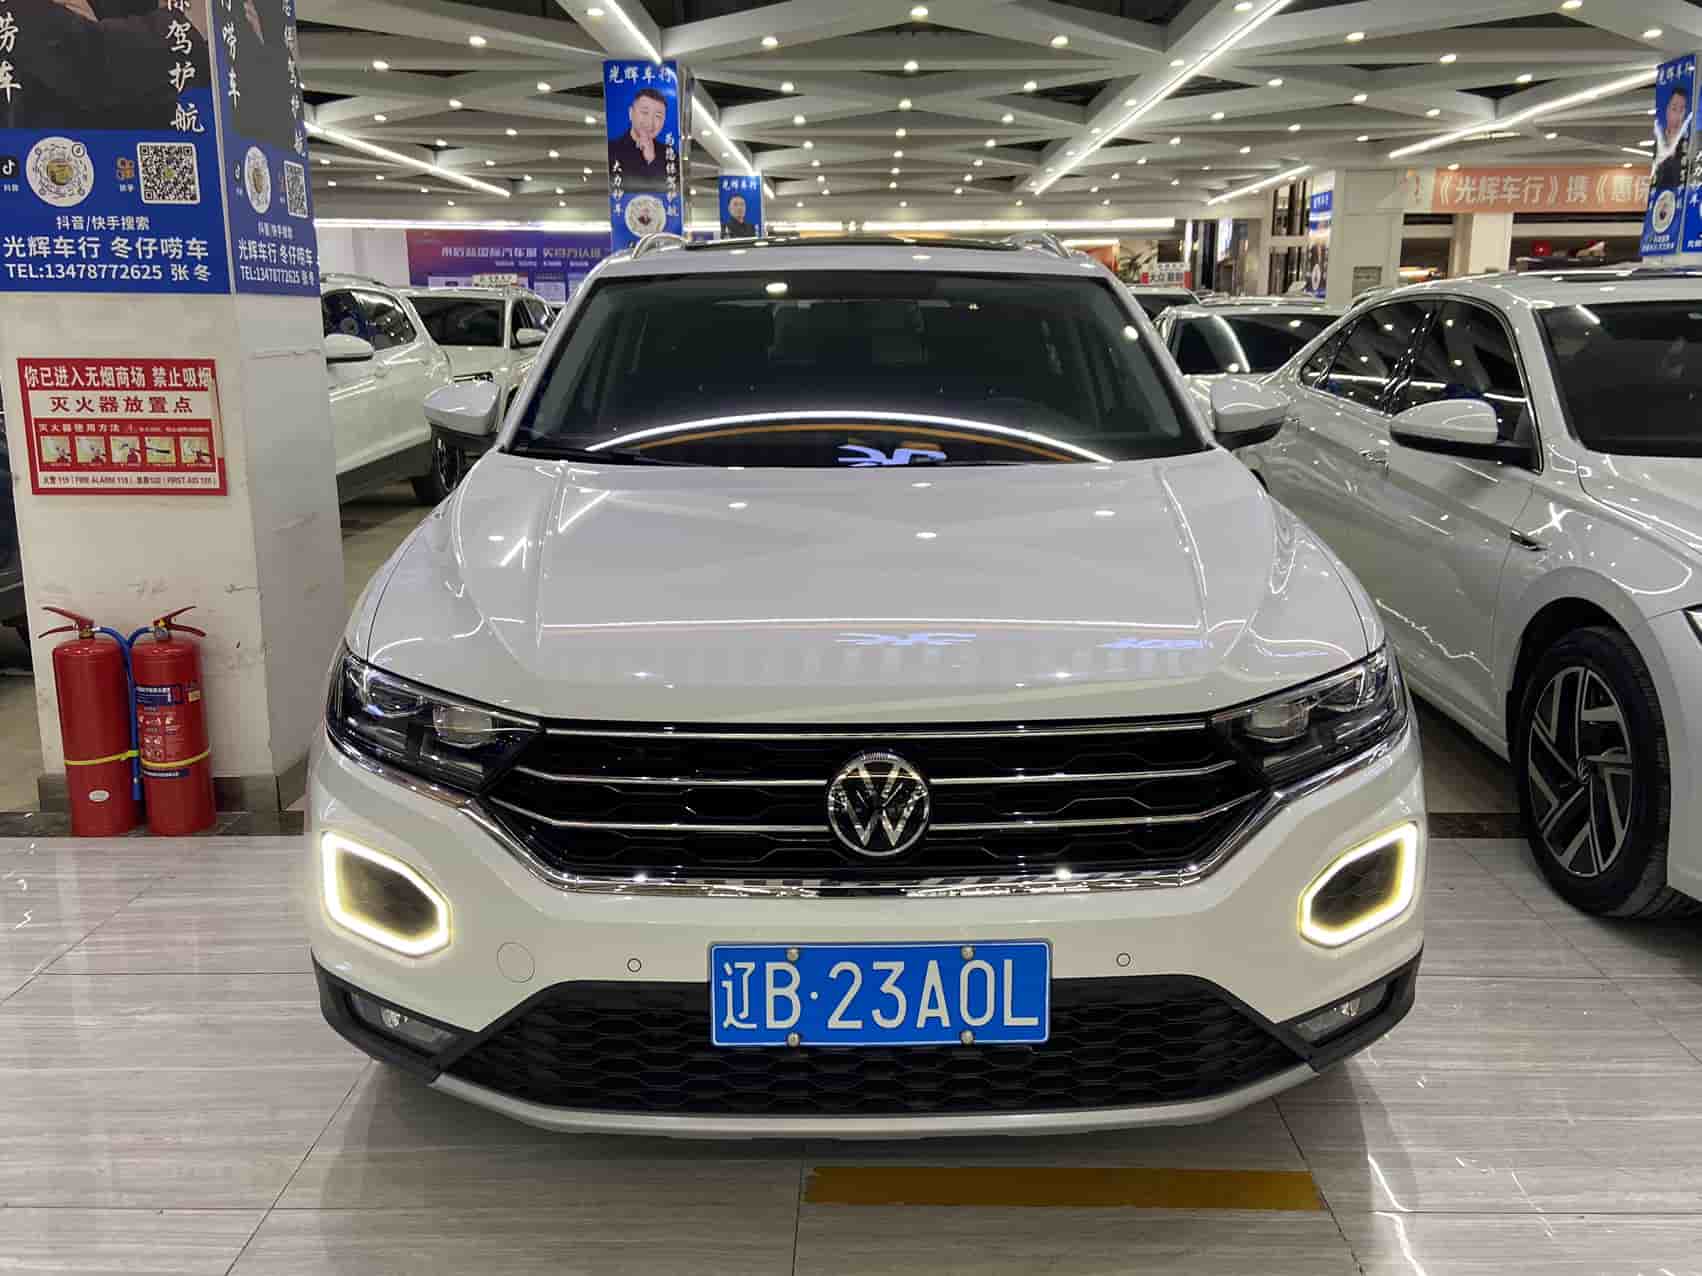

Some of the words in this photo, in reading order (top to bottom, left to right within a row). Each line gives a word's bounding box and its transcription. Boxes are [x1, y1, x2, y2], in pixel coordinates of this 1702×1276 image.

[56, 215, 150, 231] 抖音/快手搜索
[3, 235, 101, 258] 光辉车行
[111, 236, 209, 260] 冬仔唠车
[4, 263, 163, 280] TEL:13478772625
[24, 365, 146, 388] 你已进入无烟商场
[151, 365, 212, 388] 禁止吸烟
[49, 396, 193, 414] 灭火器放置点
